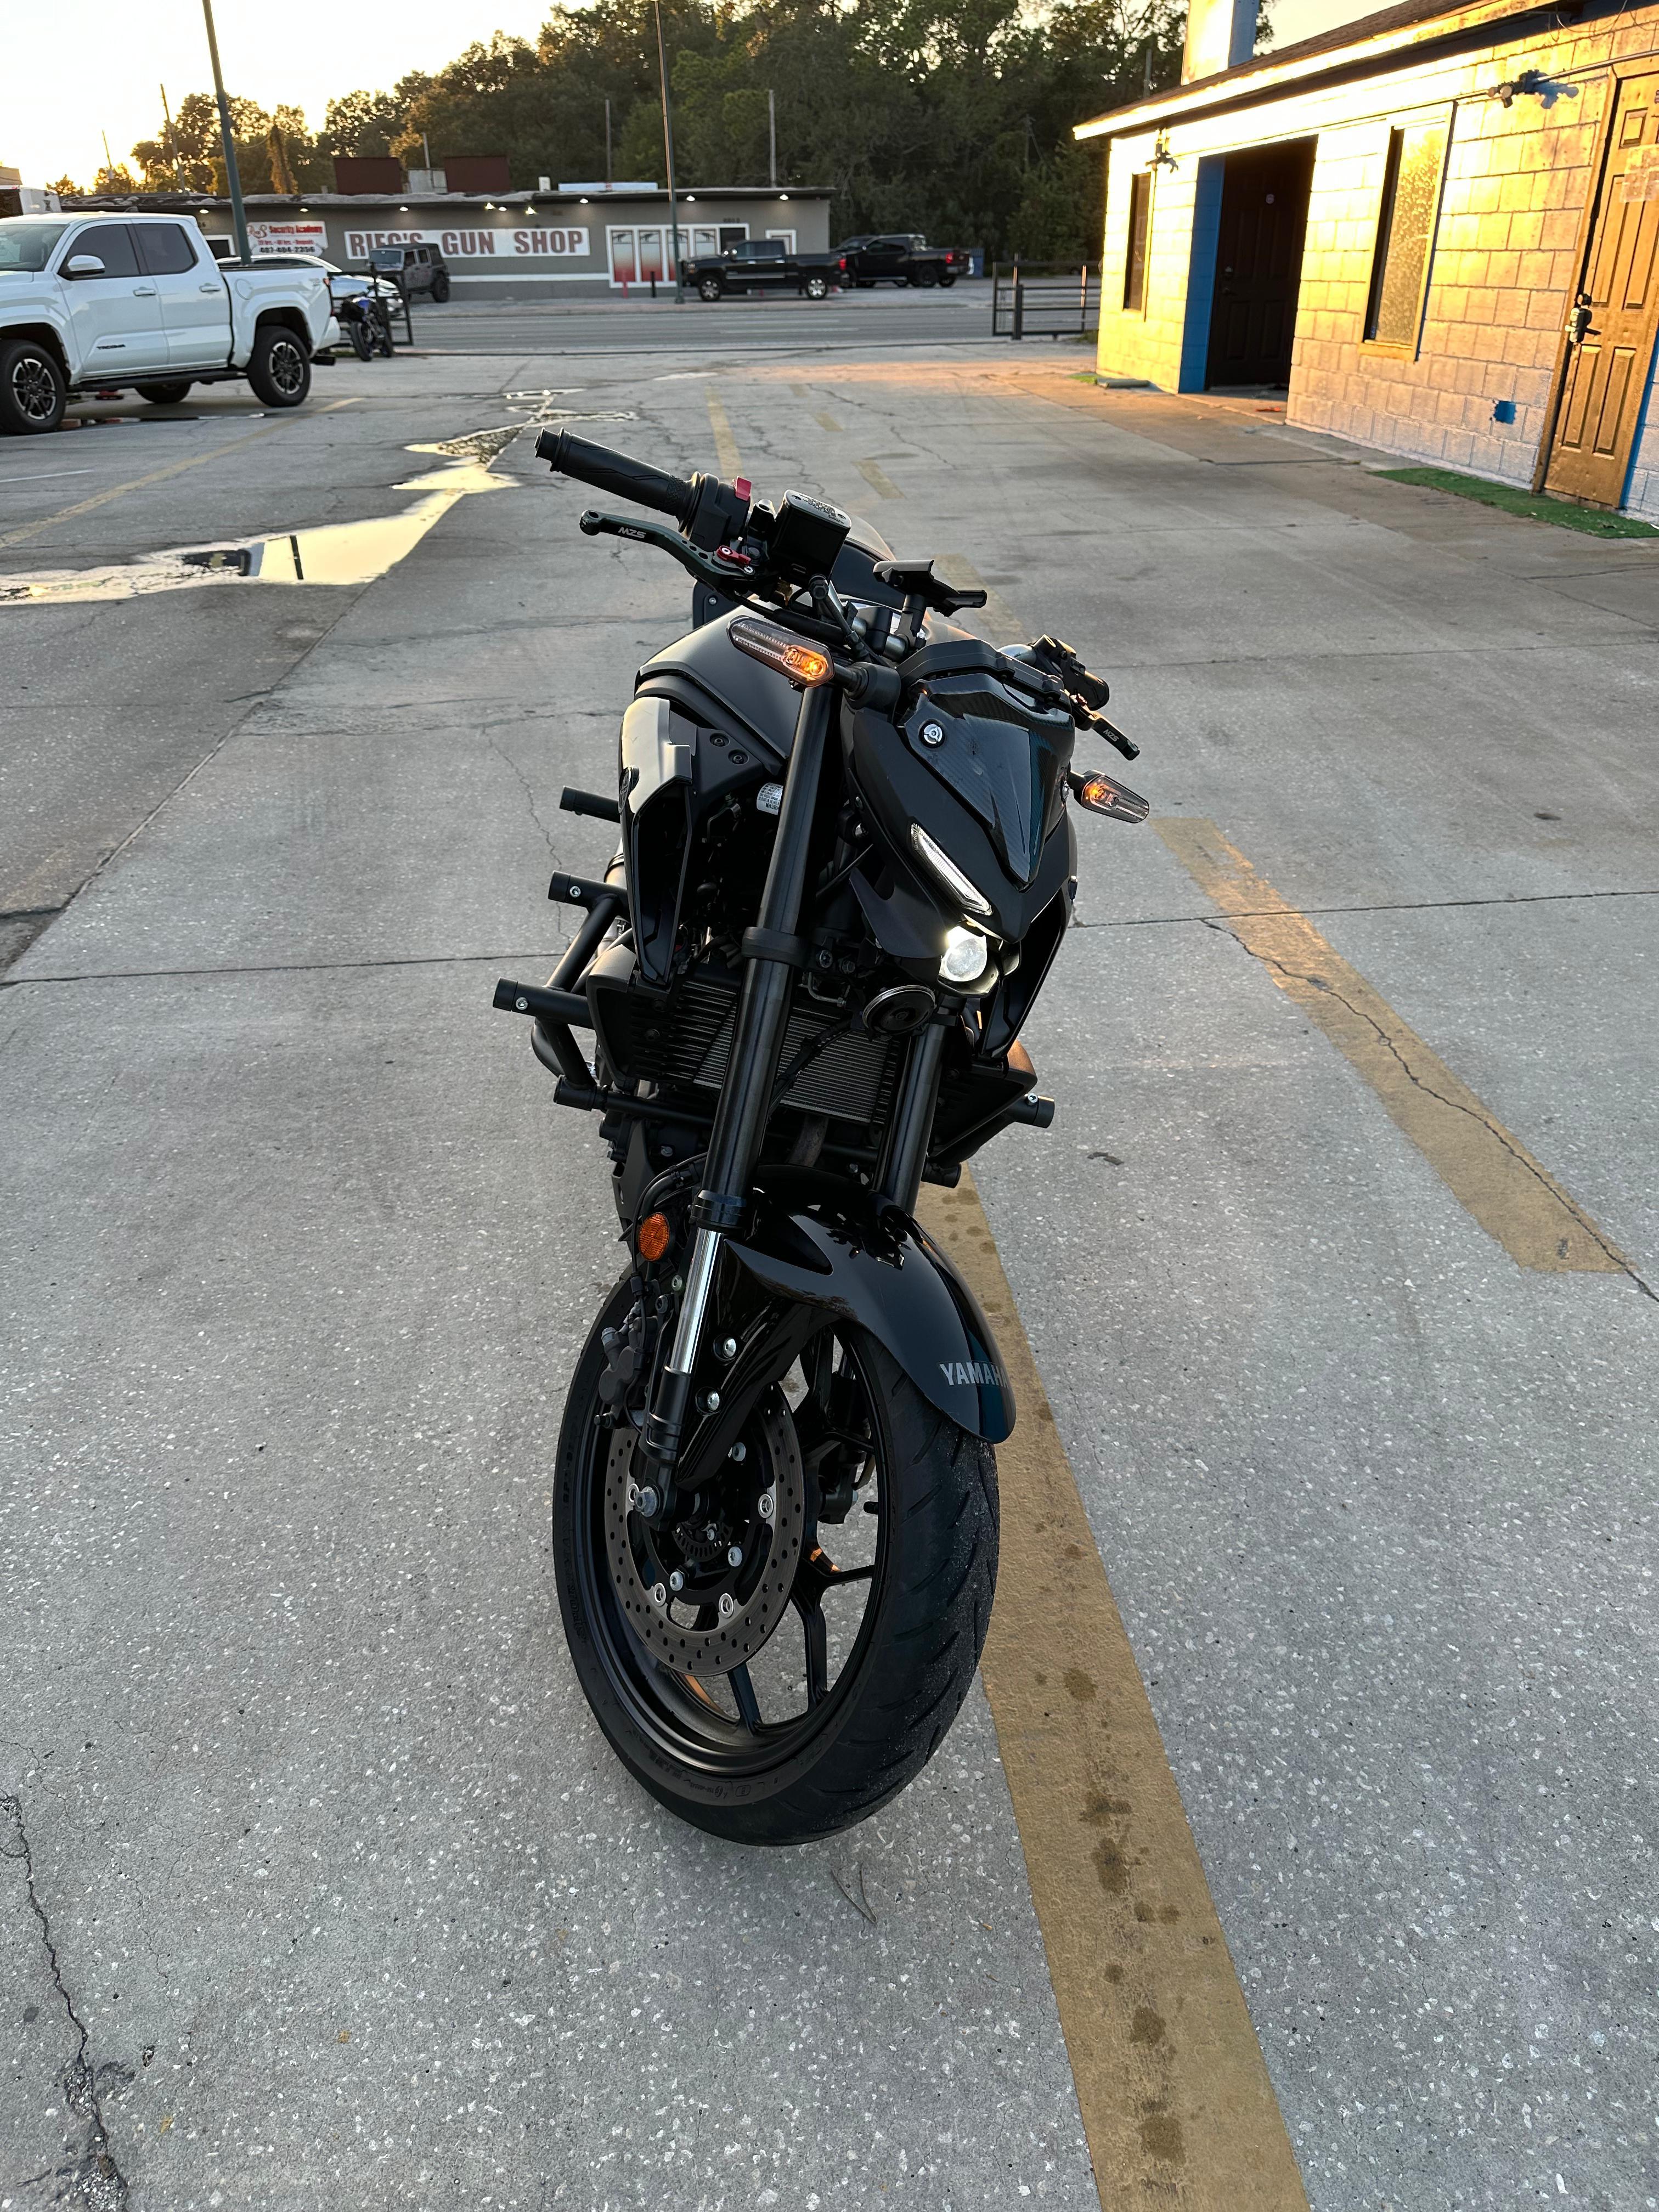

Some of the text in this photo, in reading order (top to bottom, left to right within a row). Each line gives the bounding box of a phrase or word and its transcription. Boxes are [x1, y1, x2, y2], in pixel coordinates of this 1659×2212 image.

[269, 225, 294, 234] Security
[296, 225, 323, 234] Academy
[442, 232, 496, 255] GUN
[514, 230, 583, 254] SHOP
[618, 527, 646, 538] MZS
[1103, 729, 1119, 742] MZS
[939, 1362, 1009, 1388] YAMAHA
